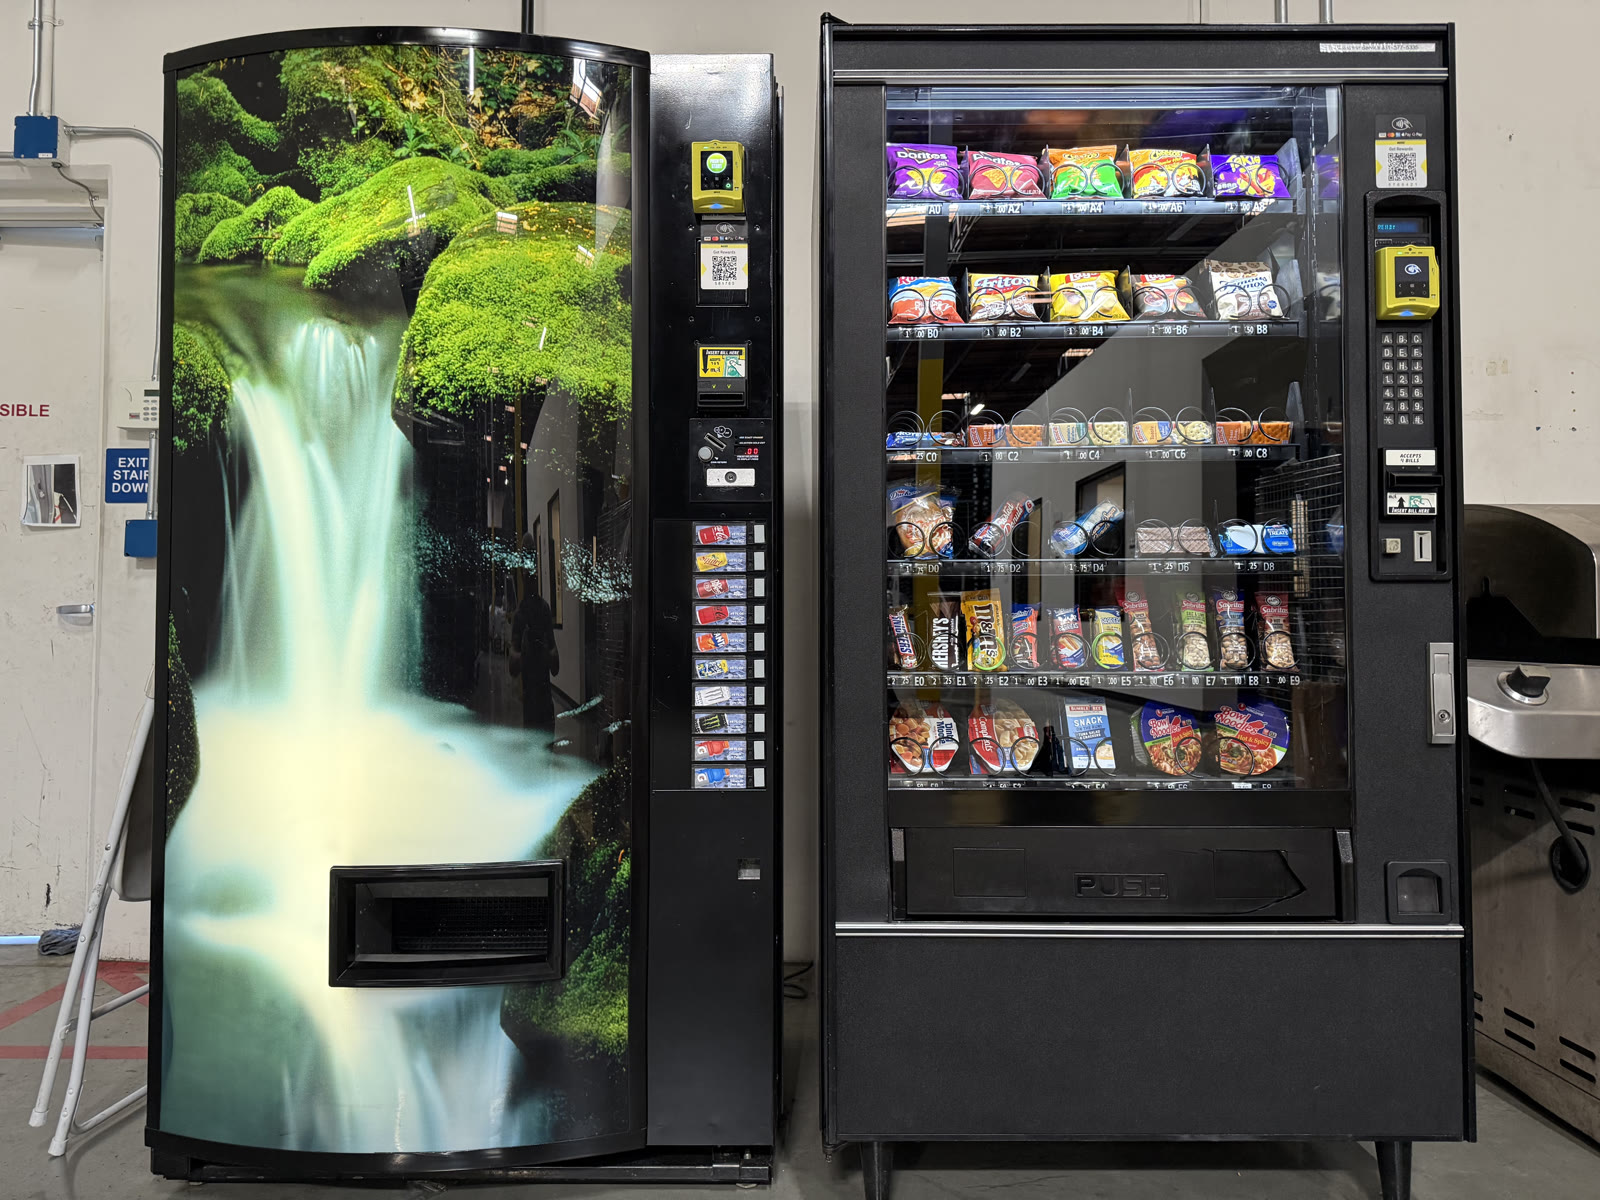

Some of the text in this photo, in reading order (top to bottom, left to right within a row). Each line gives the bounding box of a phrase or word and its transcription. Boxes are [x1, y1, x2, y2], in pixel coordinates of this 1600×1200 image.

[896, 151, 948, 160] Doritos
[928, 204, 941, 215] A0
[1008, 204, 1021, 214] A2
[1089, 203, 1103, 213] A4
[1252, 202, 1265, 211] A8
[974, 276, 1031, 289] Fritos
[927, 329, 939, 338] B0
[998, 329, 1007, 337] .00
[1010, 328, 1022, 337] B2
[1080, 327, 1089, 335] .00
[1092, 326, 1104, 336] B4
[1176, 325, 1188, 335] B6
[1256, 324, 1268, 334] B8
[1384, 335, 1419, 343] A B C
[1384, 348, 1419, 357] D E F
[1384, 362, 1419, 370] G H J
[1385, 375, 1419, 383] 1 2 3
[1384, 389, 1420, 397] 4 5 6
[0, 404, 50, 417] SIBLE
[1385, 402, 1420, 410] 7 8 9
[926, 452, 937, 462] C0
[1007, 451, 1019, 461] C2
[1079, 452, 1087, 460] .00
[1089, 450, 1100, 460] C4
[1161, 451, 1170, 459] .00
[1174, 449, 1186, 459] C6
[1243, 449, 1253, 458] .00
[1256, 448, 1268, 458] C8
[118, 457, 148, 467] EXIT
[1026, 501, 1032, 509] 6
[928, 564, 939, 573] D0
[1009, 563, 1021, 573] D2
[1093, 563, 1104, 573] D4
[1177, 562, 1189, 572] D6
[1263, 562, 1275, 571] D8
[892, 615, 912, 654] SNICERS
[914, 676, 925, 686] E0
[956, 676, 967, 686] E1
[999, 676, 1009, 686] E2
[1025, 677, 1035, 686] .00
[1037, 676, 1048, 686] E3
[1068, 677, 1077, 685] .00
[1080, 676, 1090, 686] E4
[1108, 677, 1118, 685] .00
[1121, 676, 1132, 686] E5
[1163, 676, 1174, 686] E6
[1205, 676, 1216, 686] E7
[1248, 676, 1259, 686] E8
[1277, 676, 1287, 685] .00
[1290, 676, 1301, 686] E9
[1220, 705, 1251, 722] Bowl
[1074, 716, 1103, 727] SNACK
[1148, 715, 1169, 729] Bowl
[1214, 712, 1260, 735] Noodles
[936, 721, 946, 744] Mooe
[1150, 724, 1180, 739] Noodles
[1237, 734, 1247, 742] Hot
[1254, 738, 1270, 748] Spicy
[1076, 876, 1167, 897] PUSH
